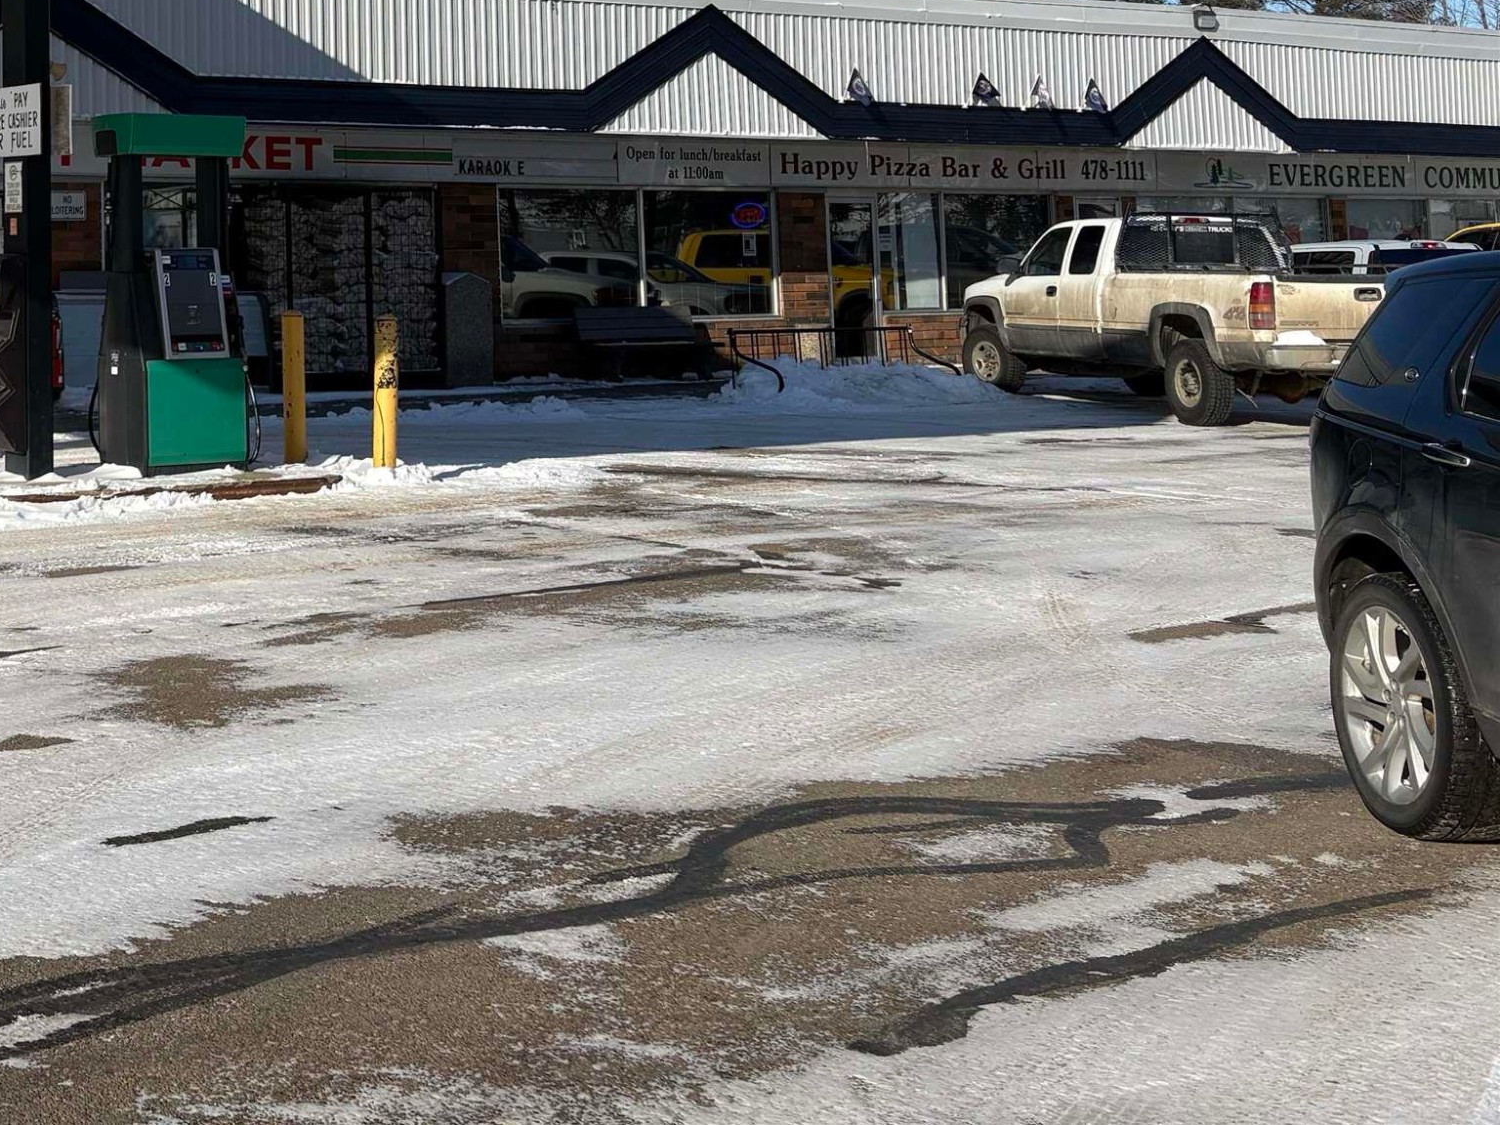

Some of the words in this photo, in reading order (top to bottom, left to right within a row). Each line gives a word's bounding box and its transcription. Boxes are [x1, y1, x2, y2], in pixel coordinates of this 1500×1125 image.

[14, 92, 28, 108] PAY
[8, 111, 38, 129] CASHIER
[11, 131, 33, 152] FUEL
[626, 146, 655, 162] Open
[660, 147, 675, 160] for
[680, 147, 761, 162] lunch/breakfast
[668, 168, 679, 179] at
[683, 166, 724, 179] 11:00am
[780, 152, 858, 180] Happy
[869, 154, 930, 177] Pizza
[941, 156, 980, 178] Bar
[991, 157, 1008, 179] &
[1018, 158, 1066, 179] Grill
[1081, 159, 1146, 181] 478-1111
[1268, 163, 1405, 188] EVERGREEN
[63, 195, 72, 203] NO
[51, 205, 83, 215] LOITERING
